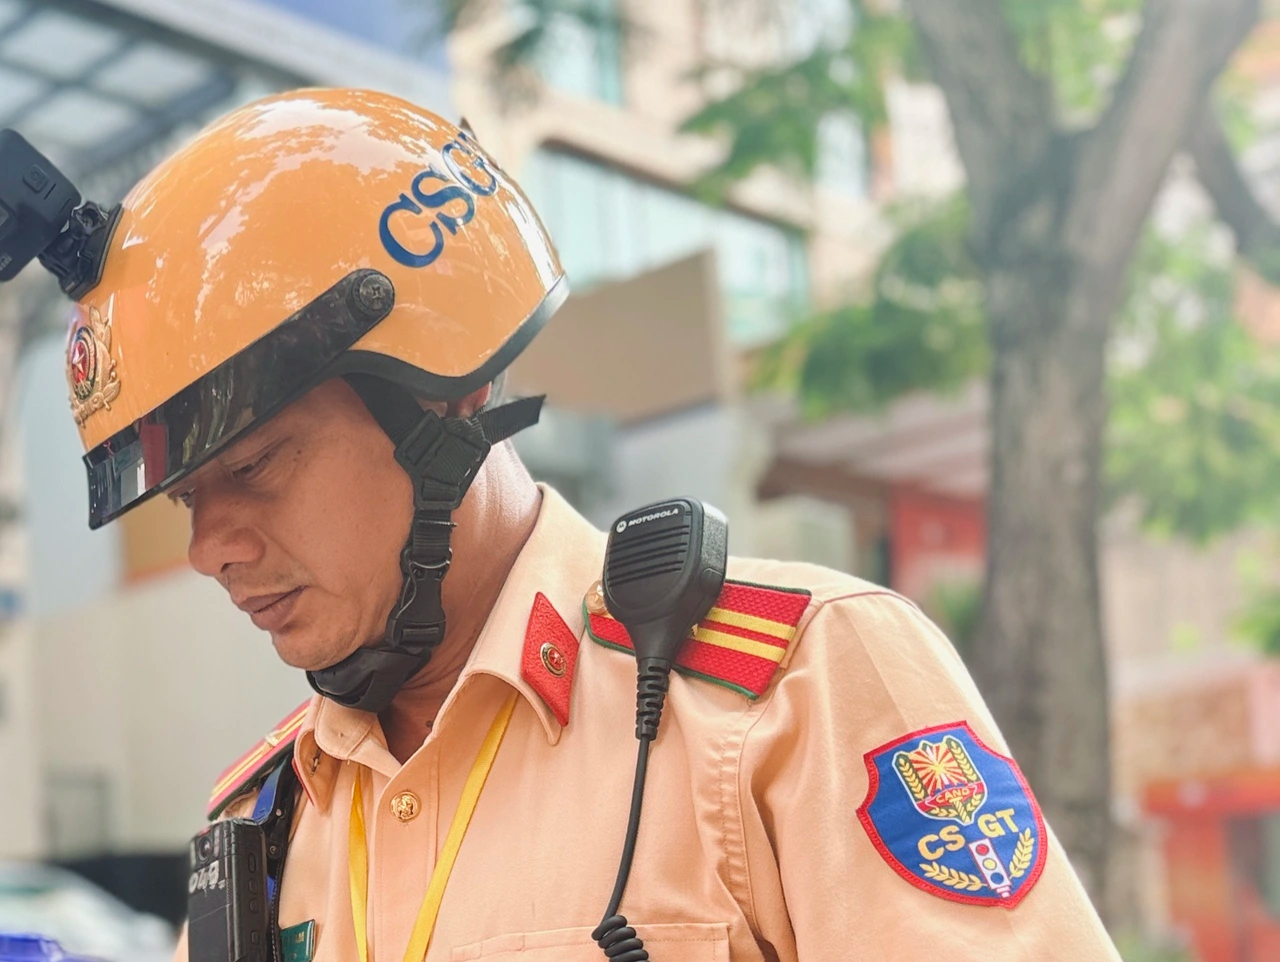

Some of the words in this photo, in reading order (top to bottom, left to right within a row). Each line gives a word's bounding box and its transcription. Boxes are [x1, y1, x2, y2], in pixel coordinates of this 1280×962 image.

[379, 131, 497, 268] CSG
[628, 508, 679, 527] MOTOROLA
[936, 787, 970, 803] CAND
[918, 825, 965, 861] CS
[977, 808, 1019, 838] GT
